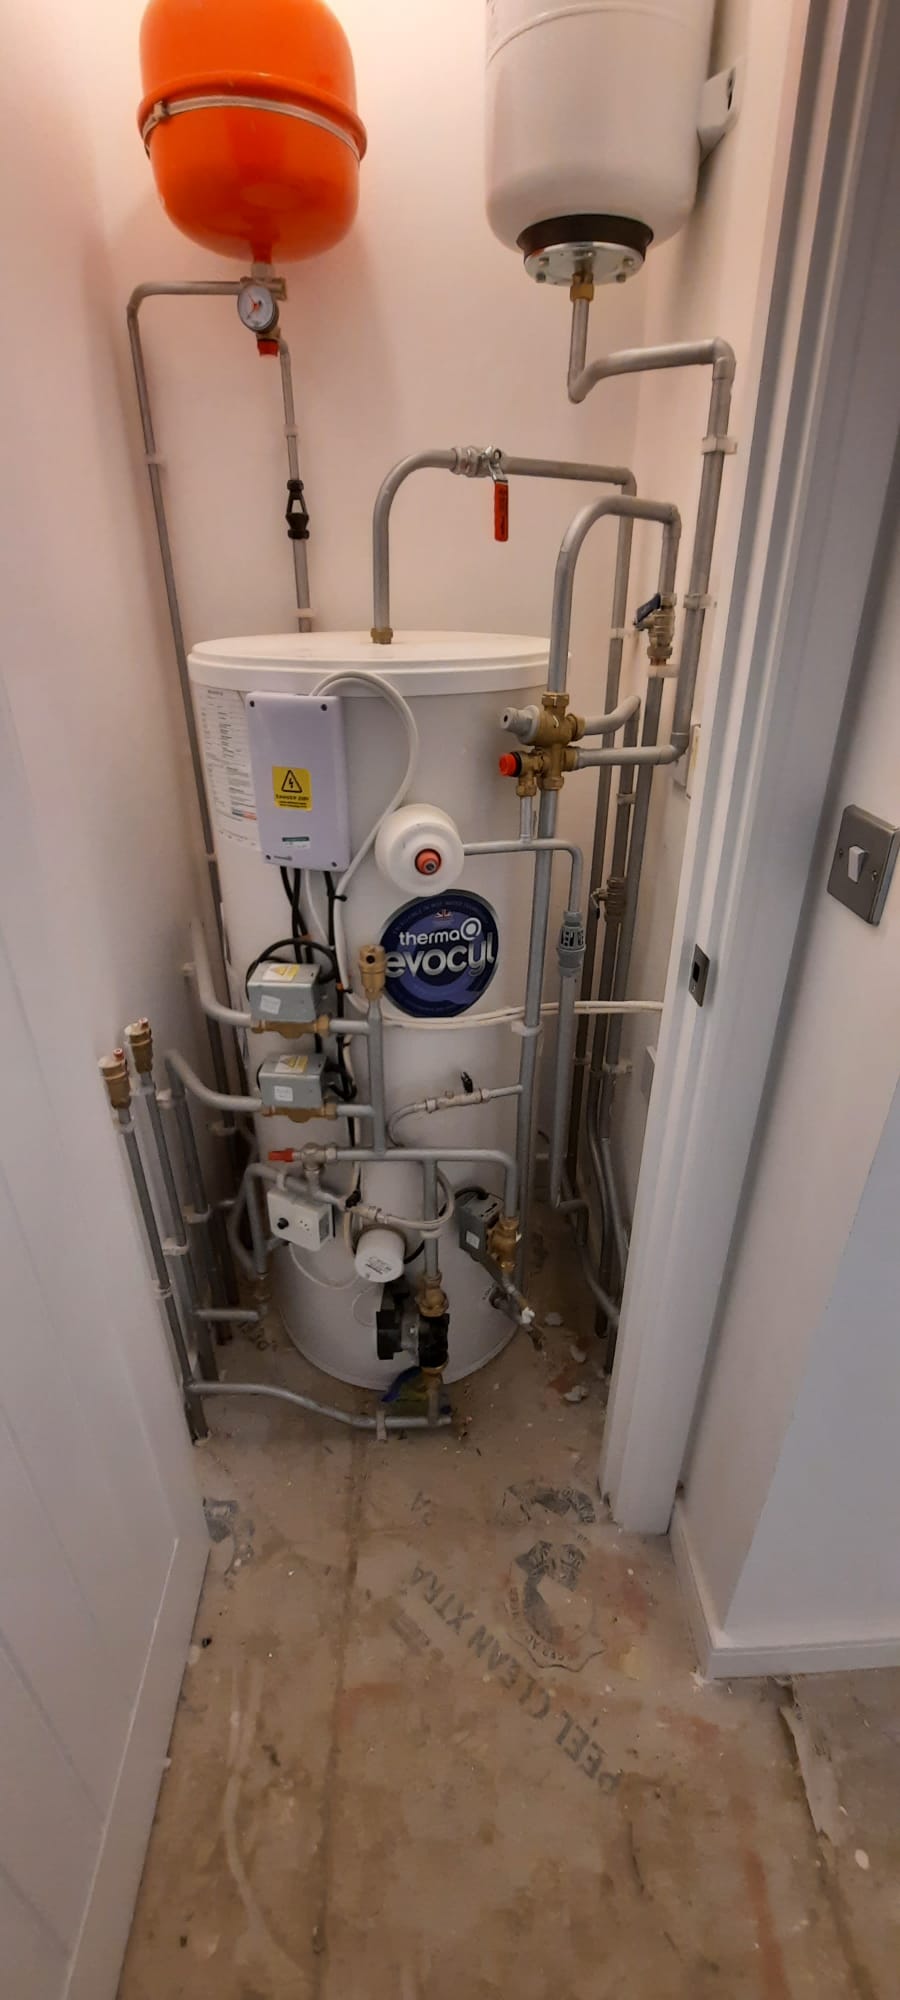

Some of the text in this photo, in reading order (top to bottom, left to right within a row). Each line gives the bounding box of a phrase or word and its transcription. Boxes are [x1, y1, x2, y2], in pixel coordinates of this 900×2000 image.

[385, 932, 495, 978] evocyl
[410, 1563, 475, 1636] XTRA
[467, 1625, 551, 1720] CLEAN
[556, 1710, 623, 1795] PEEL
